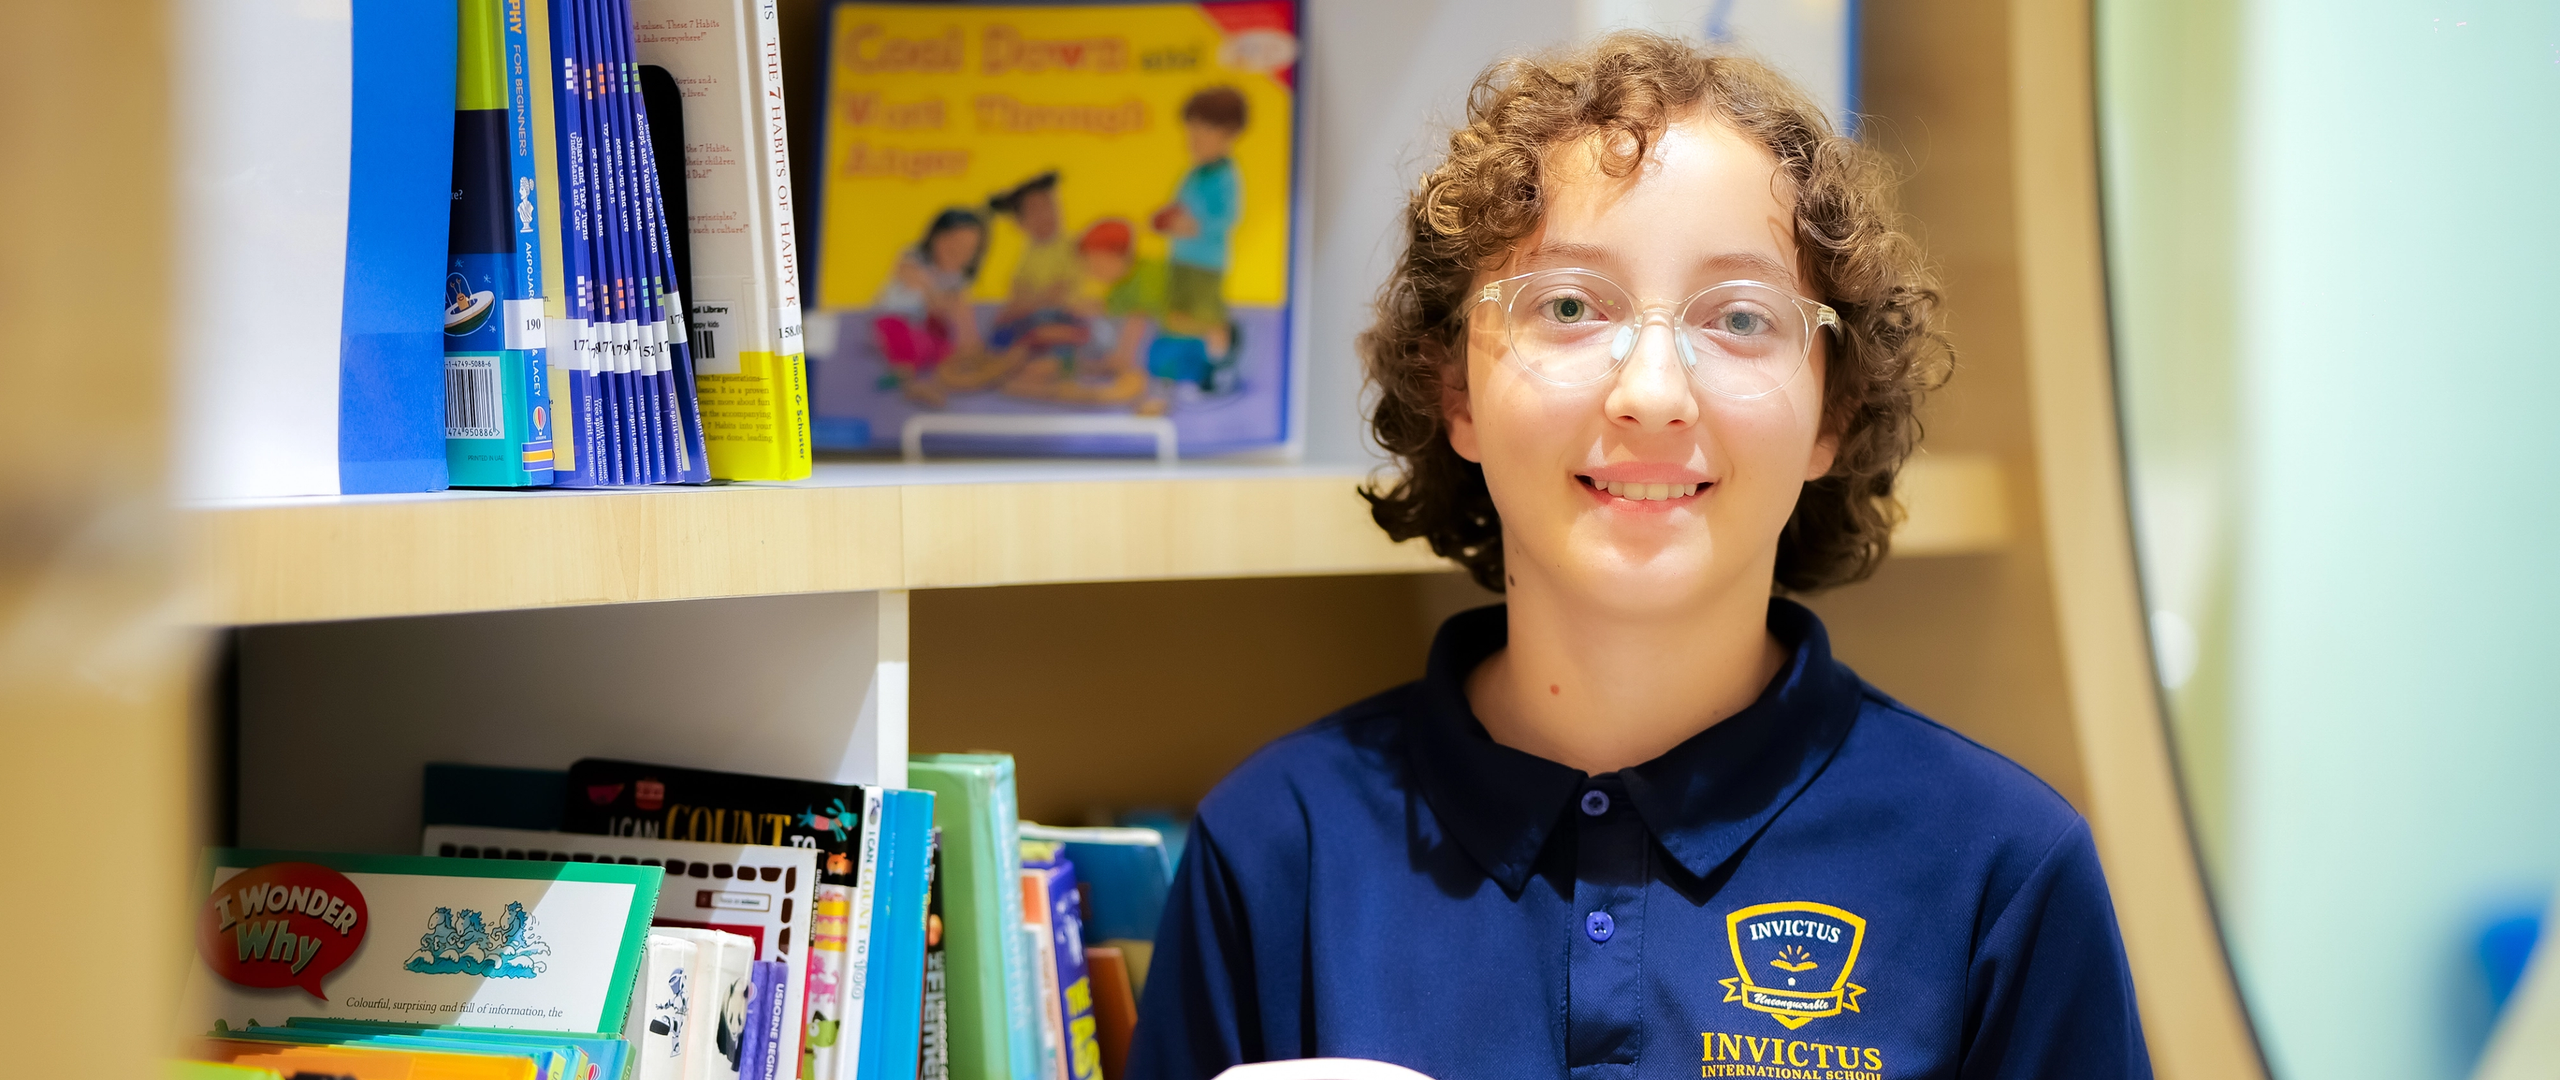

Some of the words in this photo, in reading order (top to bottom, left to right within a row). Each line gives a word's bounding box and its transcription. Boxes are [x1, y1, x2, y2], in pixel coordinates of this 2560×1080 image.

[667, 19, 688, 29] These
[690, 20, 694, 28] 7
[696, 18, 720, 28] Habits
[513, 44, 522, 75] FOR
[766, 37, 779, 81] THE
[769, 86, 782, 100] 7
[515, 78, 528, 156] BEGINNERS
[637, 113, 646, 145] Accept
[576, 136, 584, 164] Share
[699, 144, 704, 152] 7
[772, 106, 787, 178] HABITS
[570, 131, 579, 187] Understand
[640, 147, 648, 166] and
[705, 156, 736, 166] children
[642, 167, 651, 194] Value
[579, 186, 587, 210] Take
[645, 197, 655, 220] Each
[777, 184, 789, 211] OF
[649, 222, 658, 254] Person
[780, 221, 795, 288] HAPPY
[702, 305, 729, 315] Library
[526, 318, 542, 331] 190
[707, 320, 720, 328] kids
[532, 360, 541, 397] LACEY
[792, 355, 800, 391] Simon
[737, 398, 756, 406] about
[758, 398, 771, 406] fun
[745, 387, 770, 396] proven
[709, 409, 720, 418] the
[722, 410, 772, 420] accompanying
[715, 421, 737, 430] Habits
[740, 421, 754, 430] into
[755, 423, 773, 432] your
[708, 432, 724, 441] have
[747, 432, 774, 444] leading
[618, 816, 660, 839] CAN
[665, 803, 792, 847] COUNT
[866, 835, 876, 864] CAN
[214, 893, 237, 932] I
[239, 882, 358, 935] WONDER
[859, 867, 873, 934] COUNT
[1749, 919, 1841, 944] INVICTUS
[237, 919, 322, 975] Why
[857, 939, 867, 954] TO
[852, 958, 867, 1000] 100
[346, 996, 391, 1010] Colourful,
[392, 1000, 437, 1014] surprising
[439, 1001, 457, 1013] and
[458, 1002, 475, 1014] full
[476, 1003, 489, 1015] of
[489, 1003, 546, 1019] information,
[548, 1007, 563, 1018] the
[770, 983, 785, 1039] USBORNE
[1701, 1032, 1883, 1071] INVICTUS
[1701, 1064, 1822, 1080] INTERNATIONAL
